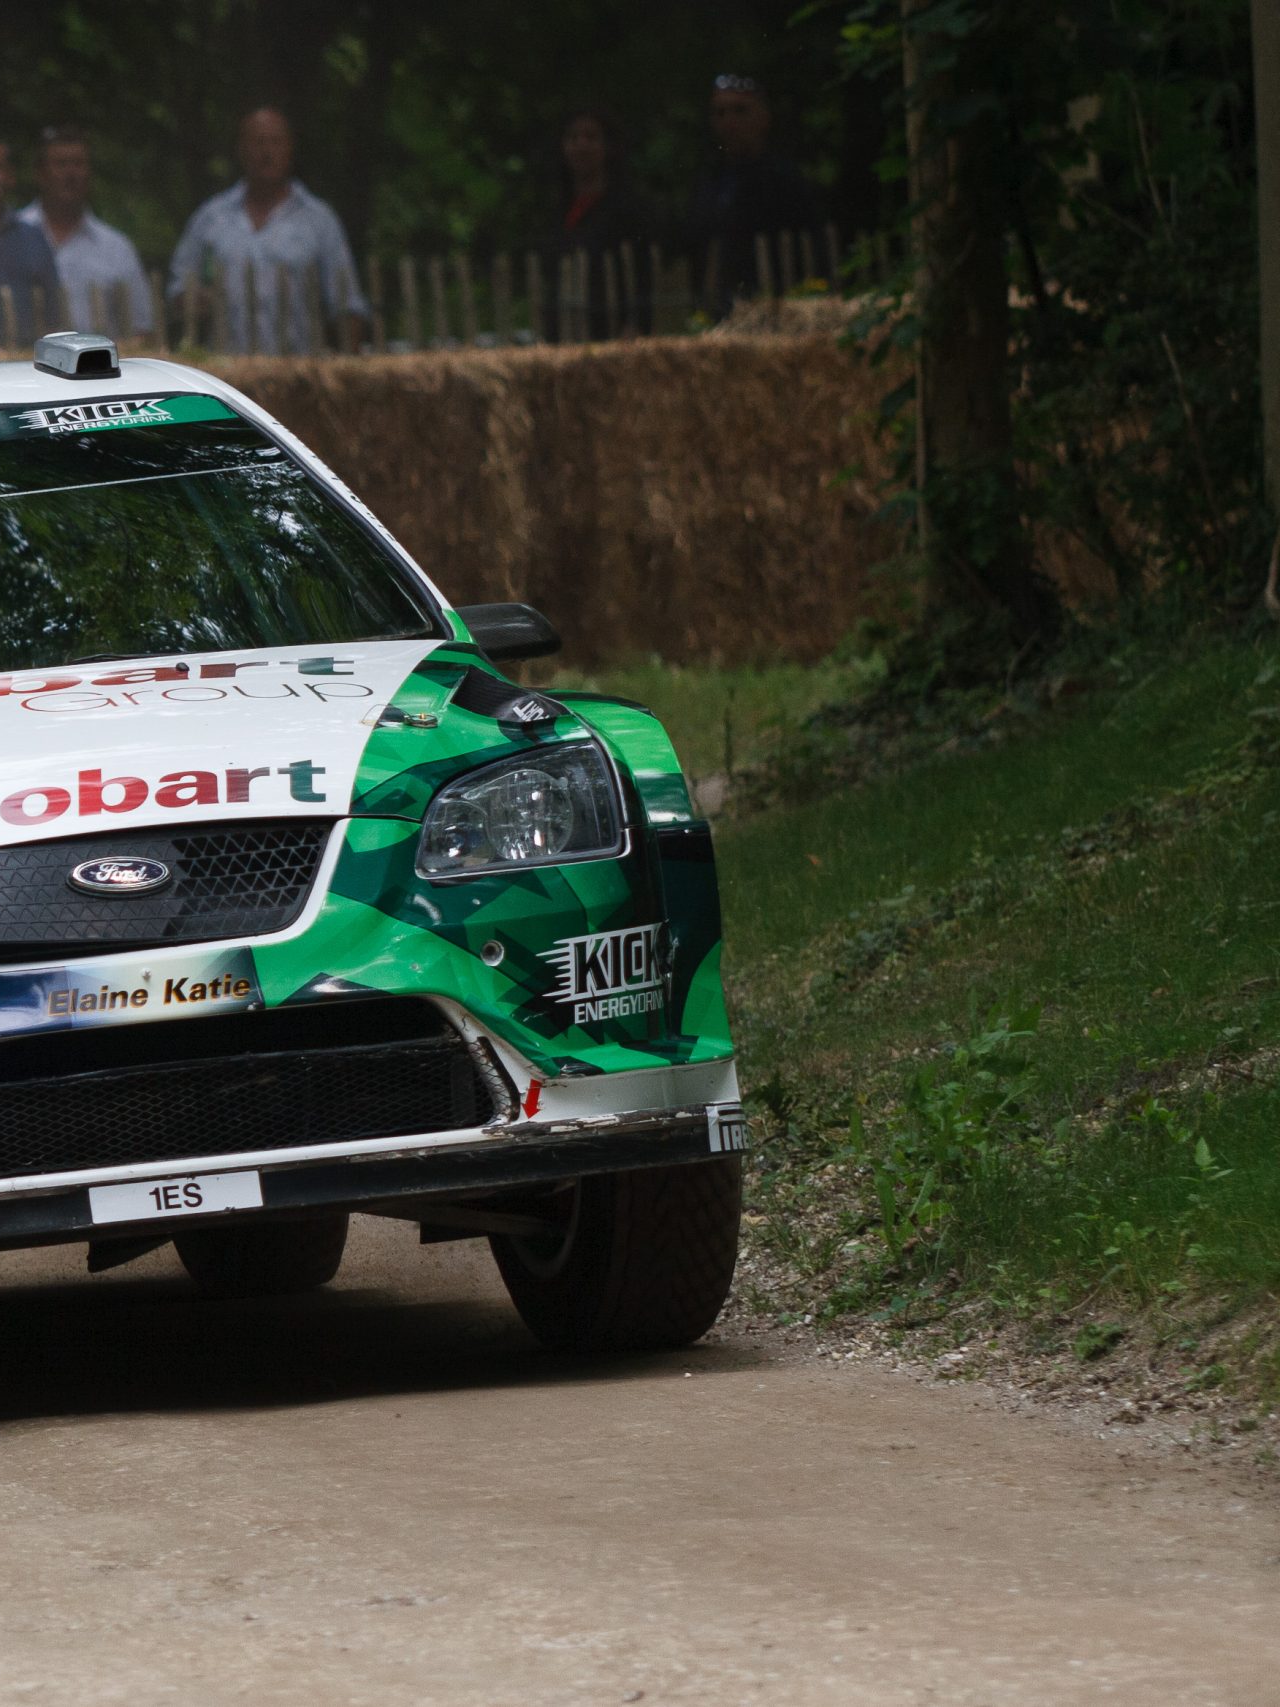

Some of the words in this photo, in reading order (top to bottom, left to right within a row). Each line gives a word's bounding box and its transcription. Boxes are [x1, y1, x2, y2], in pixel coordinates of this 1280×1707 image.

[23, 399, 171, 427] KICK
[20, 682, 375, 714] Group
[47, 984, 149, 1017] Elaine
[163, 973, 251, 1005] Katie
[148, 1182, 204, 1211] 1ES
